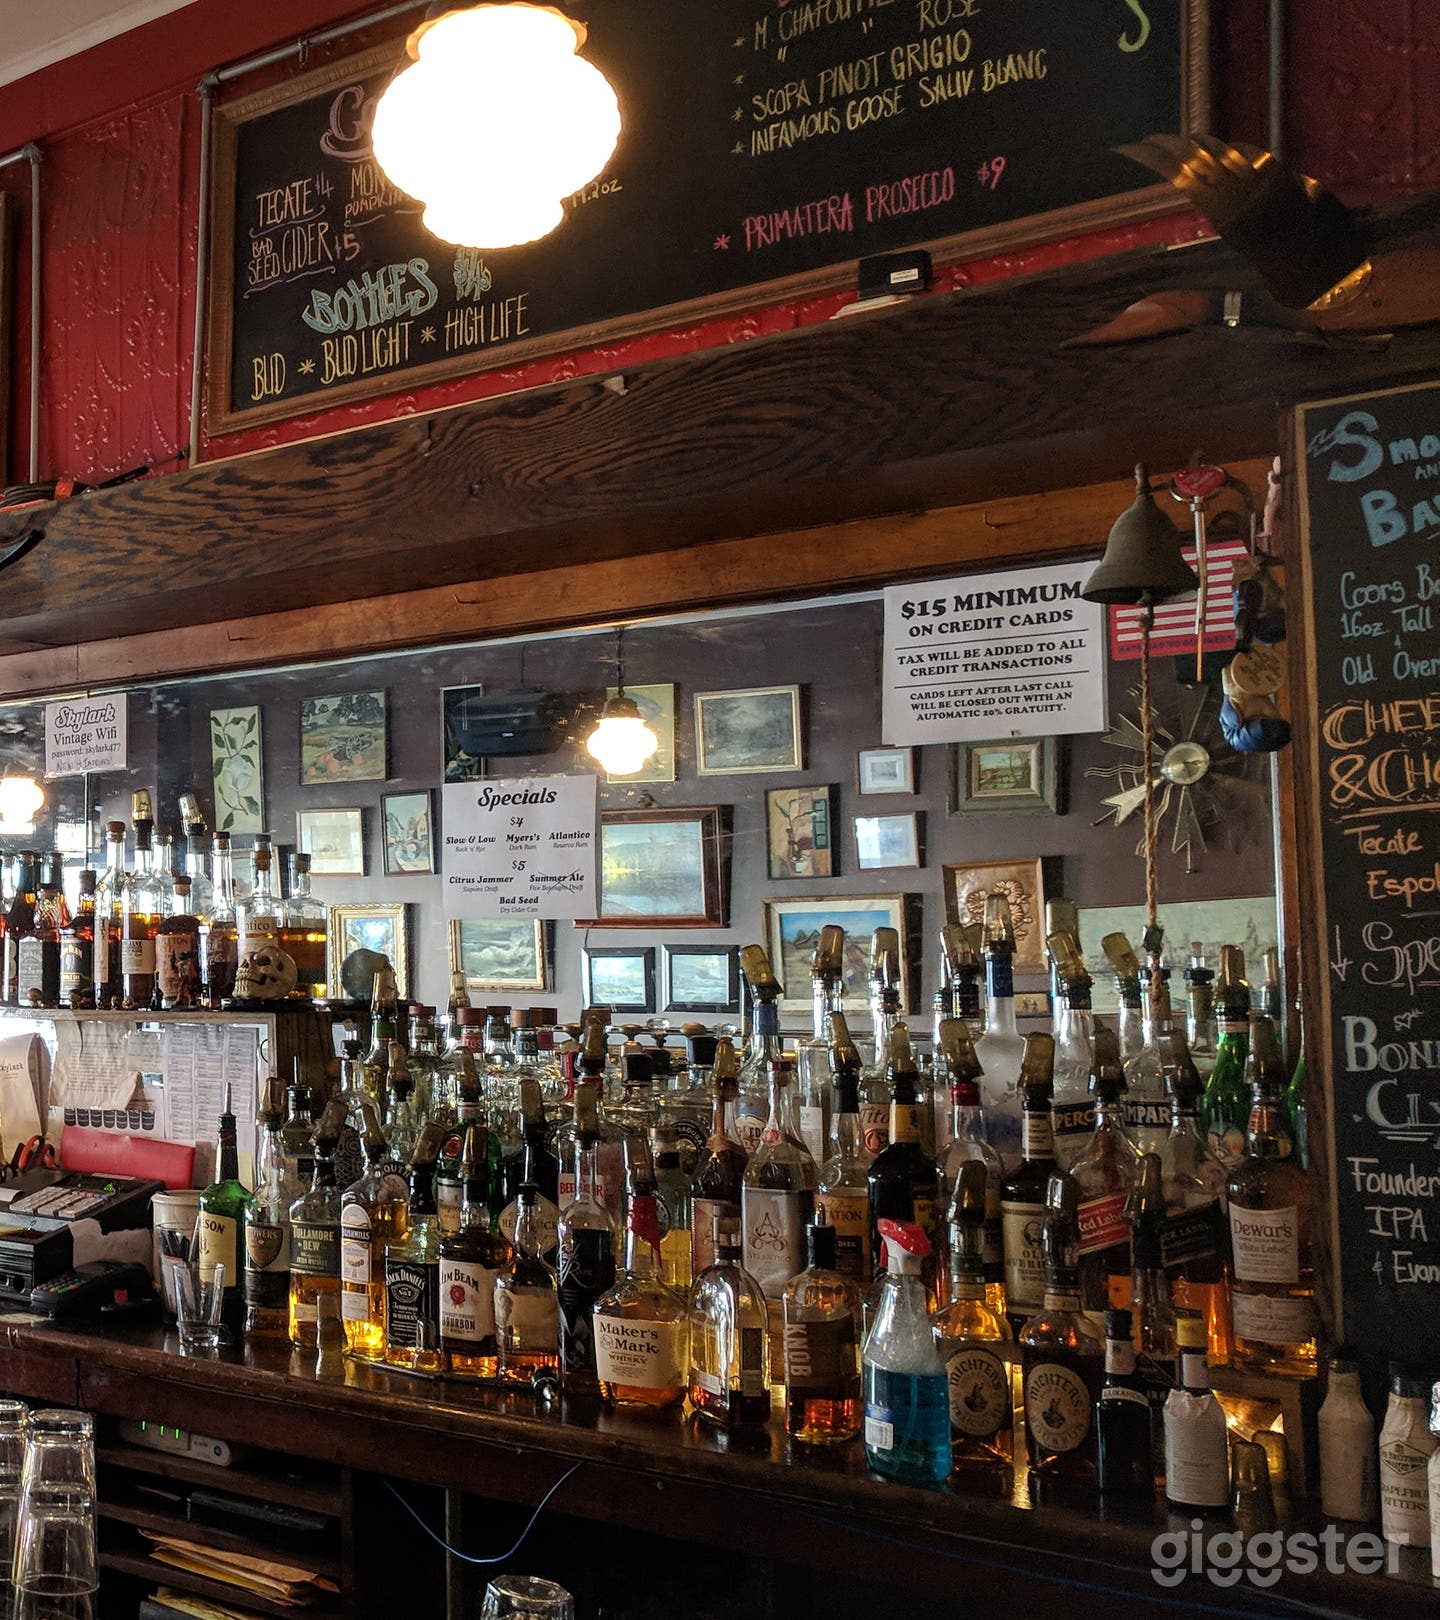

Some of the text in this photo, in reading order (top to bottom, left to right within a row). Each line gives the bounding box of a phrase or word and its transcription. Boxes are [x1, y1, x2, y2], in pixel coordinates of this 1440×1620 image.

[752, 28, 972, 121] SCOPA PINOT GRIGIO
[751, 107, 841, 156] INFAMOUS
[846, 84, 907, 131] GOOSE
[983, 48, 1048, 92] BLANC
[256, 178, 314, 227] TECATE
[742, 156, 1007, 252] PRIMATERA PROSECCO $9
[248, 254, 281, 286] SEED
[282, 222, 334, 274] CIDER
[252, 237, 273, 258] BAD
[301, 257, 439, 334] BOTTLES
[251, 292, 530, 401] BUD BUD LIGHT HIGH LIFE
[1415, 461, 1440, 480] AN
[901, 580, 1082, 620] $15 MINIMUM
[1341, 571, 1406, 610] Coors
[909, 608, 1073, 637] ON CREDIT CARDS
[1392, 604, 1434, 633] Tall
[898, 638, 1086, 665] TAX WILL BE ADDED TO ALL
[910, 654, 1073, 677] CREDIT TRANSACTIONS
[1342, 653, 1378, 686] Old
[910, 680, 1074, 701] CARDS LEFT AFTER LAST CALL
[911, 690, 1073, 711] WILL BE CLOSED OUT WITH AN
[55, 703, 116, 733] Skylark
[916, 703, 1067, 722] AUTOMATIC 20% GRATUITY.
[53, 726, 117, 746] Vintage Wifi
[477, 787, 558, 812] Specials
[510, 816, 524, 828] $4
[445, 836, 466, 845] Slow
[478, 835, 496, 844] Low
[506, 833, 541, 843] Myers's
[548, 830, 591, 841] Atlantico
[1343, 824, 1423, 855] Tecate
[512, 860, 527, 872] $5
[449, 875, 475, 884] Citrus
[477, 875, 514, 884] Jammer
[529, 874, 568, 883] Summer
[499, 895, 539, 905] Bad Seed
[292, 1225, 334, 1241] TULLAMORE
[1234, 1219, 1293, 1239] Dewar's
[1364, 1205, 1428, 1242] IPA
[454, 1268, 479, 1293] BEAM
[600, 1321, 659, 1339] Maker's
[615, 1338, 660, 1354] Mark
[785, 1322, 812, 1378] KNOB
[608, 1353, 648, 1365] WHISKY
